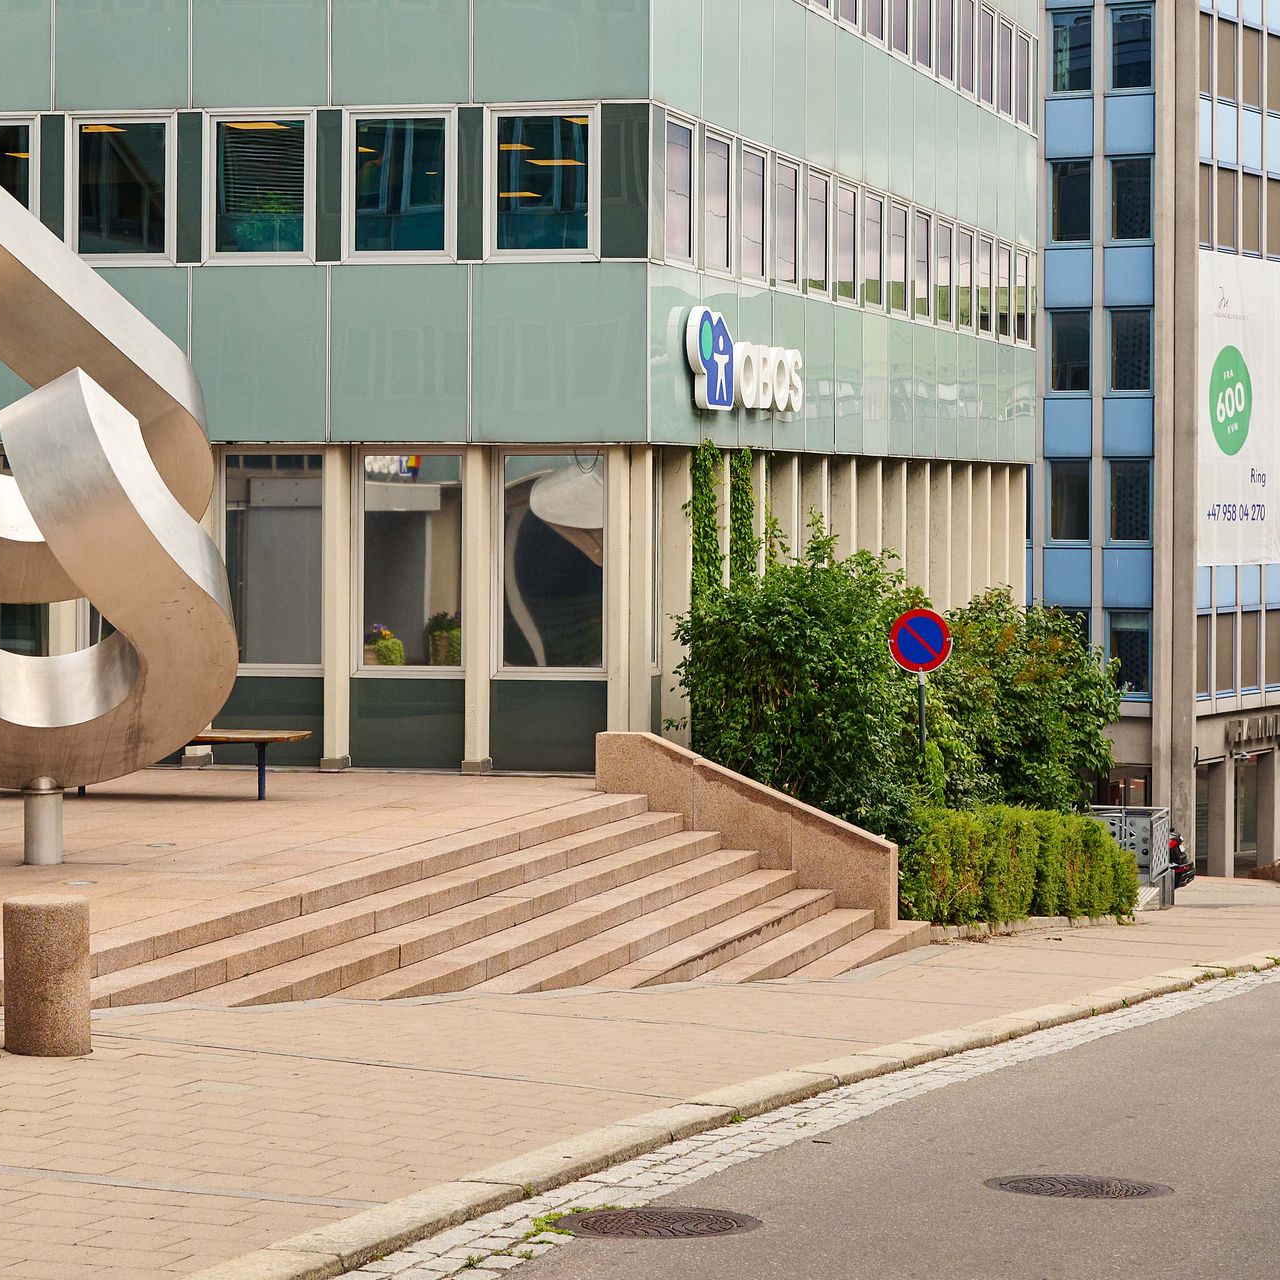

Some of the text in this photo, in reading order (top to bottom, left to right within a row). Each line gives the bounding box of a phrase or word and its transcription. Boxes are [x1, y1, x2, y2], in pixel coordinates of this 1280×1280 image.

[734, 341, 802, 413] OBOS
[1223, 369, 1234, 380] FRA
[1216, 381, 1245, 423] 600
[1250, 467, 1266, 487] Ring
[1207, 504, 1265, 521] +47 958 04 270
